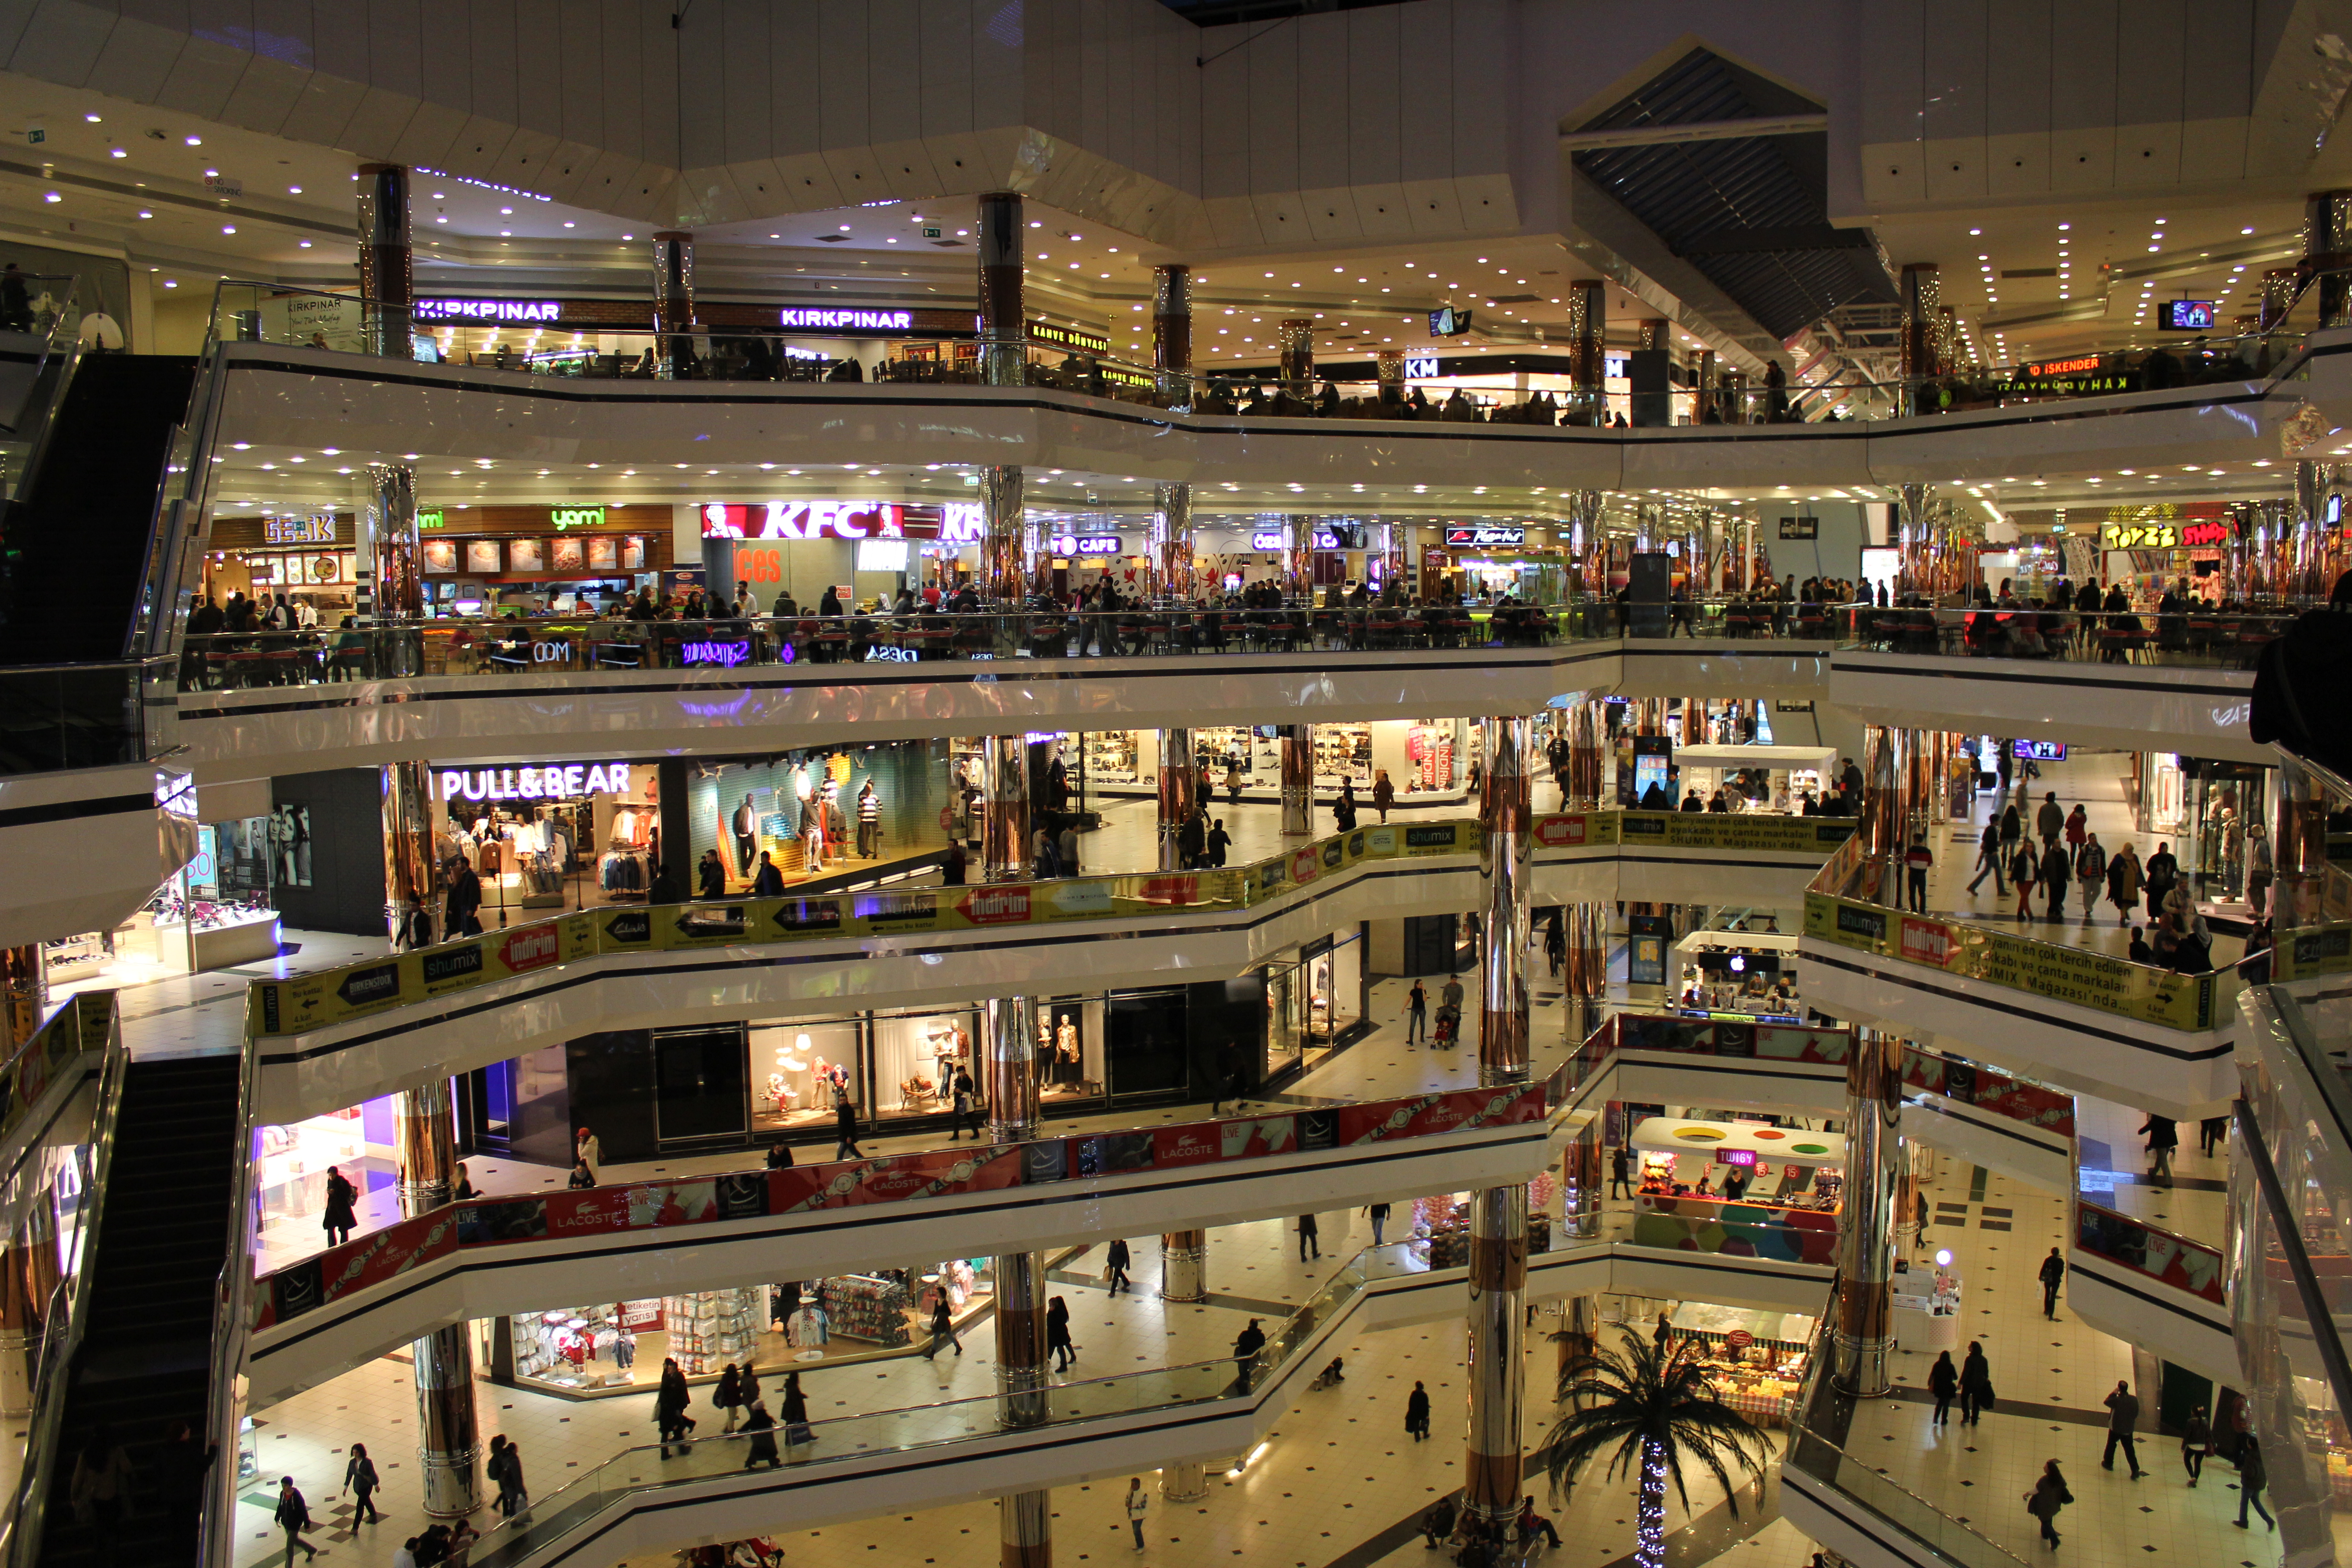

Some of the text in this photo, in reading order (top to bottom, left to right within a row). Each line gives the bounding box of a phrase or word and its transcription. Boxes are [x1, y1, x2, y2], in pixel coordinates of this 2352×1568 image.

[288, 299, 341, 312] KIRKPINAR
[782, 309, 910, 328] KIRKPINAR
[1034, 325, 1107, 351] KAHVE DÜNYASI
[1406, 359, 1439, 377] KM
[1102, 370, 1127, 383] KAHVE
[552, 507, 605, 531] yami
[760, 503, 870, 539] KFC
[1474, 530, 1523, 543] Pizza Hut
[1079, 539, 1117, 552] CAFE
[442, 764, 630, 801] PULL&BEAR
[1544, 820, 1583, 838] indirim
[1626, 819, 1661, 831] shumix
[1733, 818, 1749, 827] çok
[1753, 818, 1779, 828] tercih
[1782, 820, 1812, 829] edilen
[1410, 829, 1452, 844] shumix
[1670, 836, 1715, 845] SHUMIX
[1733, 828, 1760, 838] çanta
[970, 892, 1027, 916] indirim
[1841, 911, 1882, 933] shumix
[1903, 923, 1949, 956] indirim
[510, 932, 556, 963] indirim
[428, 951, 478, 976] shumix
[2022, 945, 2035, 957] en
[2038, 948, 2057, 962] çok
[2060, 951, 2092, 969] tercih
[2095, 958, 2131, 978] edilen
[2021, 960, 2034, 971] ve
[2037, 963, 2069, 982] çanta
[349, 974, 392, 994] BIRKENSTOCK
[293, 990, 302, 999] Bu
[265, 988, 278, 1031] shumix
[1425, 1112, 1464, 1125] LACOSTE
[1162, 1144, 1214, 1159] LACOSTE
[1720, 1152, 1753, 1164] TWIGY
[1756, 1167, 1766, 1176] 15
[1787, 1168, 1796, 1177] 15
[874, 1179, 921, 1191] LACOSTE
[557, 1212, 619, 1228] LACOSTE
[376, 1249, 409, 1268] LACOSTE
[627, 1300, 660, 1310] etiketin
[624, 1311, 654, 1325] yarısı
